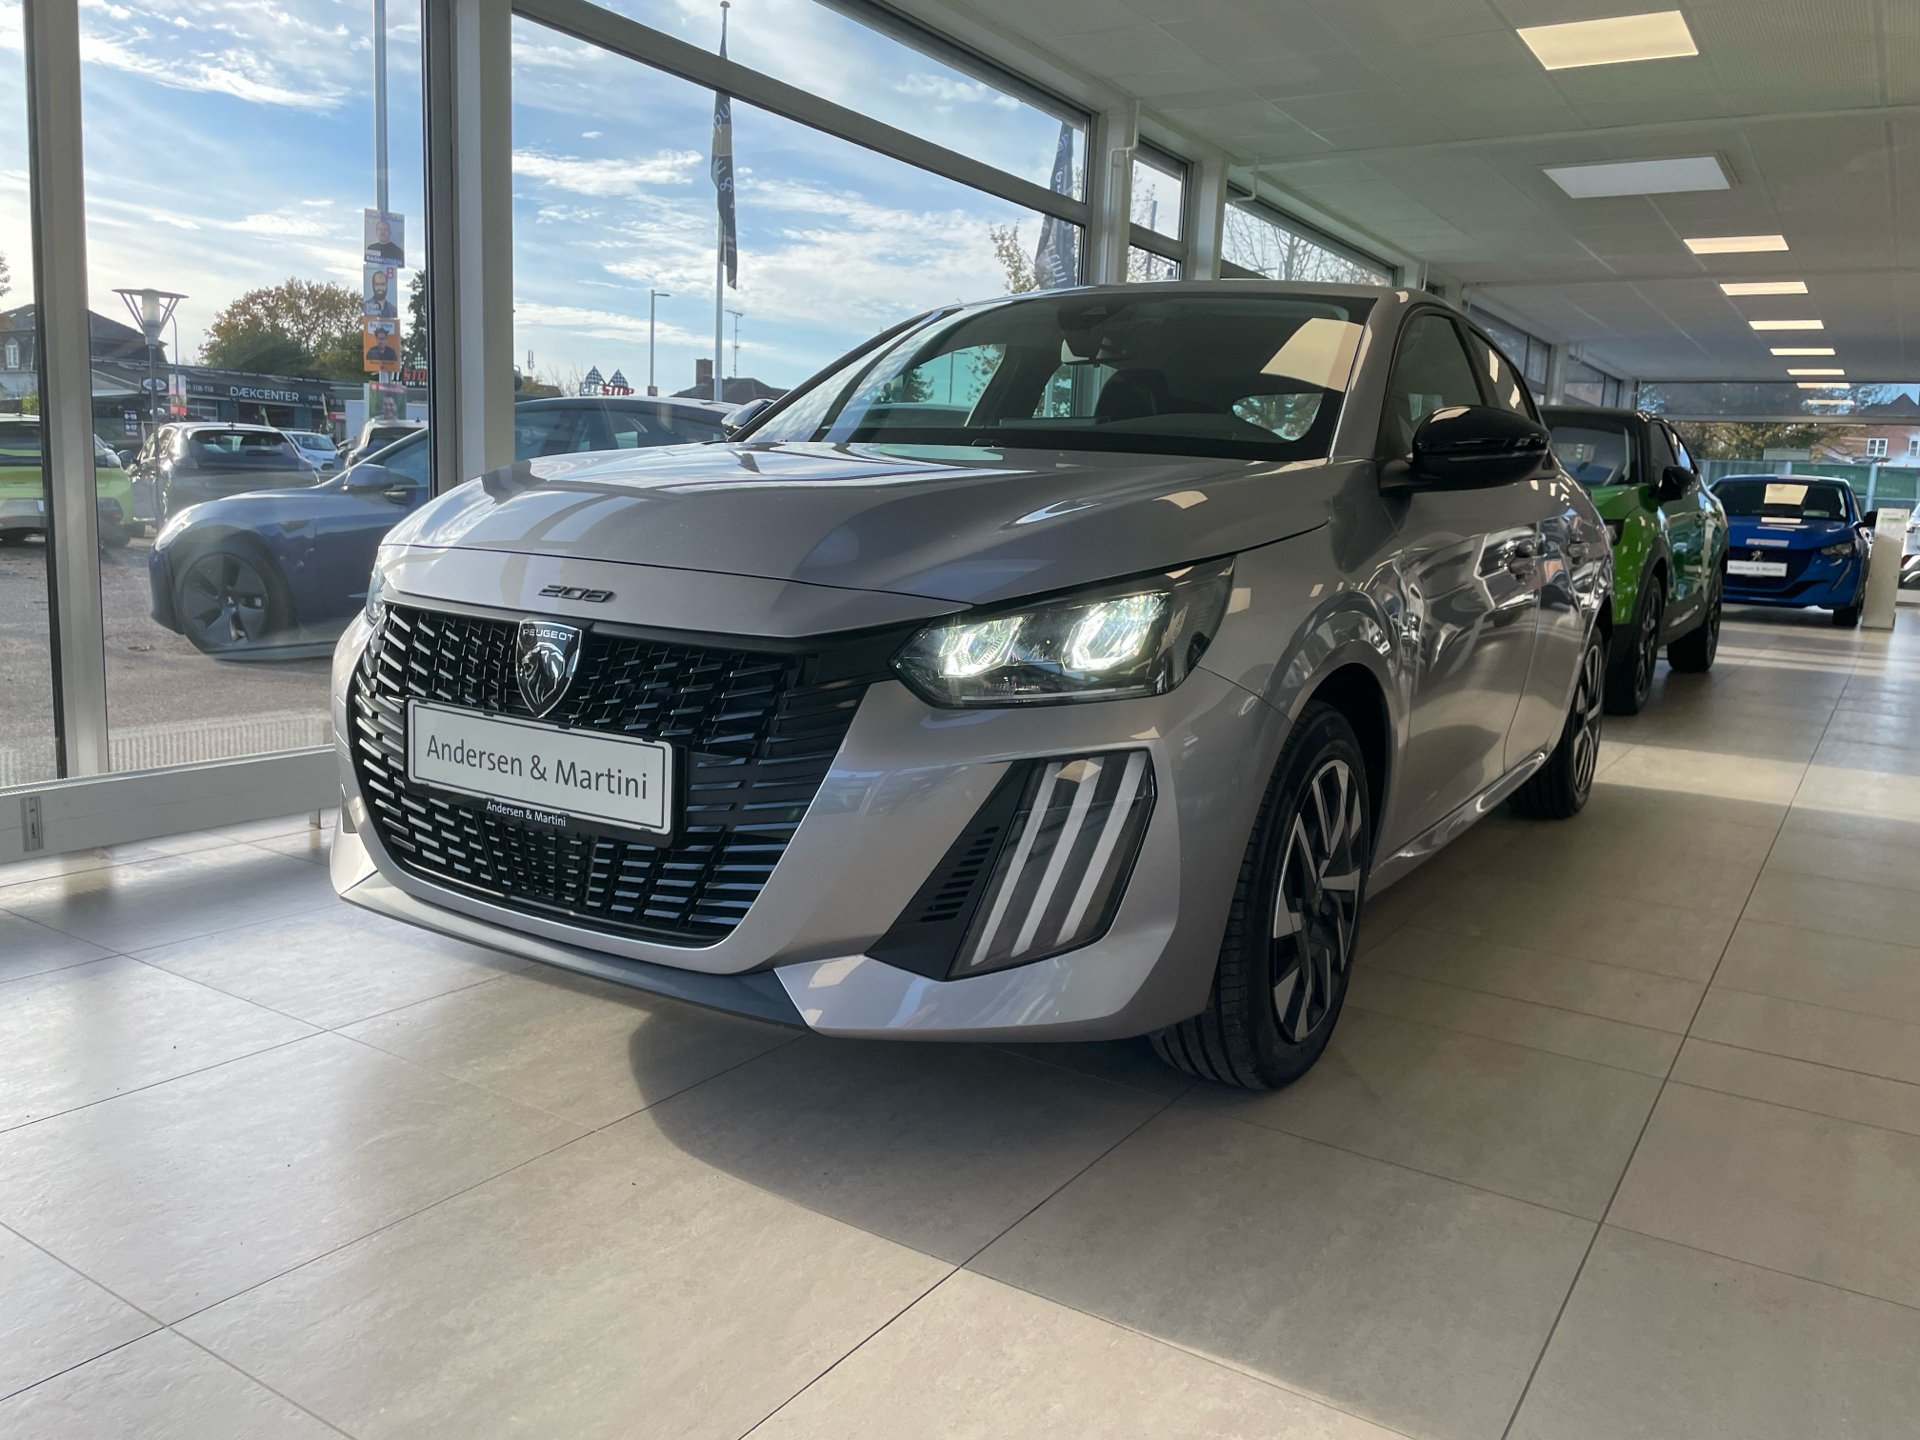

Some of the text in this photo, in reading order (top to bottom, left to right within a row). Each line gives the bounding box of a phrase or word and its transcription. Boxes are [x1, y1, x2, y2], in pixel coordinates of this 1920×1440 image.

[366, 255, 403, 267] RASMUSSEN
[386, 267, 395, 279] B
[229, 386, 300, 402] DÆKCENTER
[537, 584, 614, 603] 208
[522, 628, 575, 641] PEUGEOT
[427, 735, 647, 799] Andersen & Martini
[486, 801, 566, 827] Andersen & Martini
